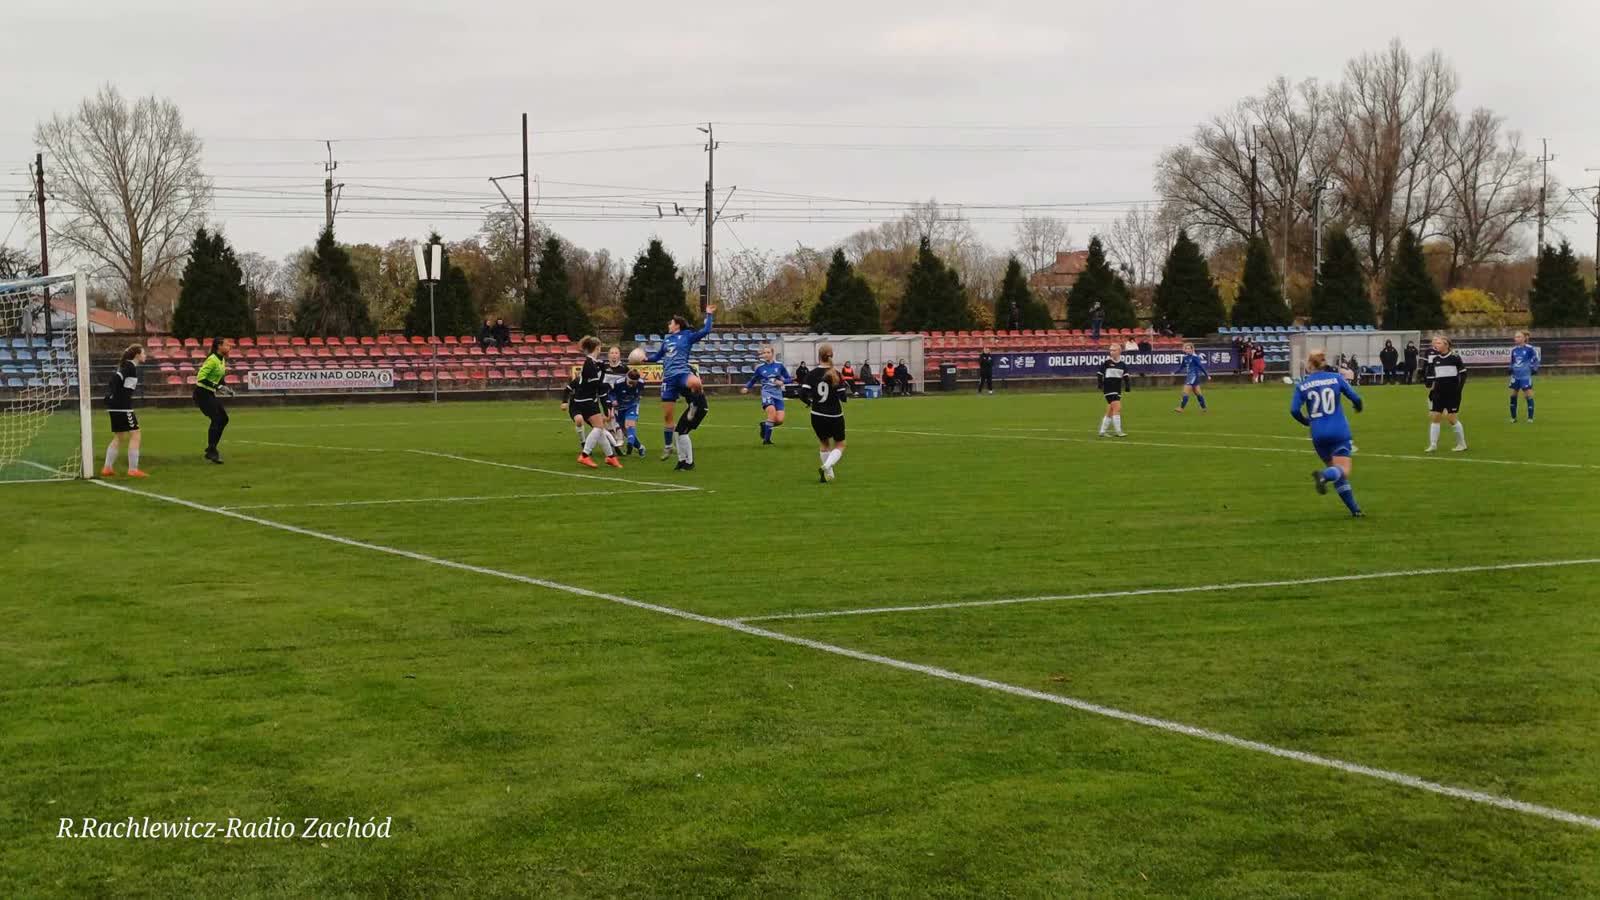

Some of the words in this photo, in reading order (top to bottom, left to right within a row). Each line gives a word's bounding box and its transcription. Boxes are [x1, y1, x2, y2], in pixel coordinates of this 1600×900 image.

[1048, 356, 1079, 367] ORLEN
[1120, 354, 1152, 365] POLSKI
[1153, 353, 1185, 364] KOBIET
[262, 371, 318, 381] KOSTRZYN
[320, 370, 344, 380] NAD
[345, 370, 377, 381] ODRĄ
[817, 381, 830, 403] 9
[1307, 387, 1336, 418] 20
